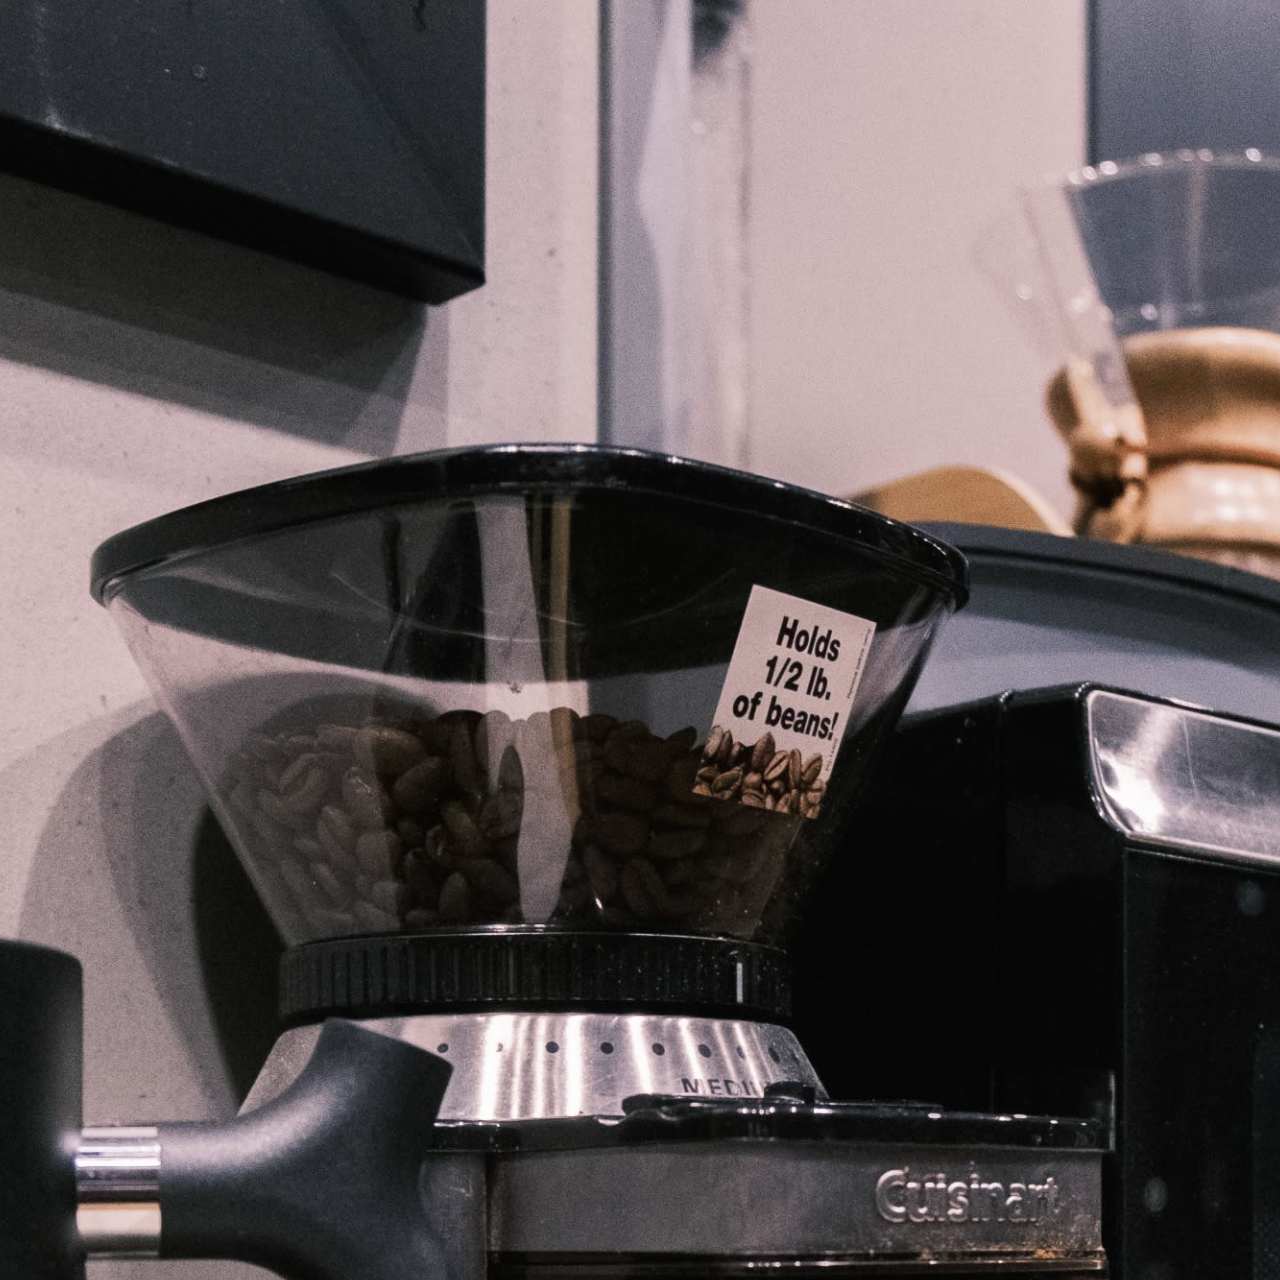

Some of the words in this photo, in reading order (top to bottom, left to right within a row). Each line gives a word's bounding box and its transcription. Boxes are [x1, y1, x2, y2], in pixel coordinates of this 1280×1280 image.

[776, 615, 841, 662] Holds
[765, 655, 804, 691] 1/2
[806, 665, 832, 701] lb.
[732, 691, 763, 721] of
[765, 695, 839, 741] beans!
